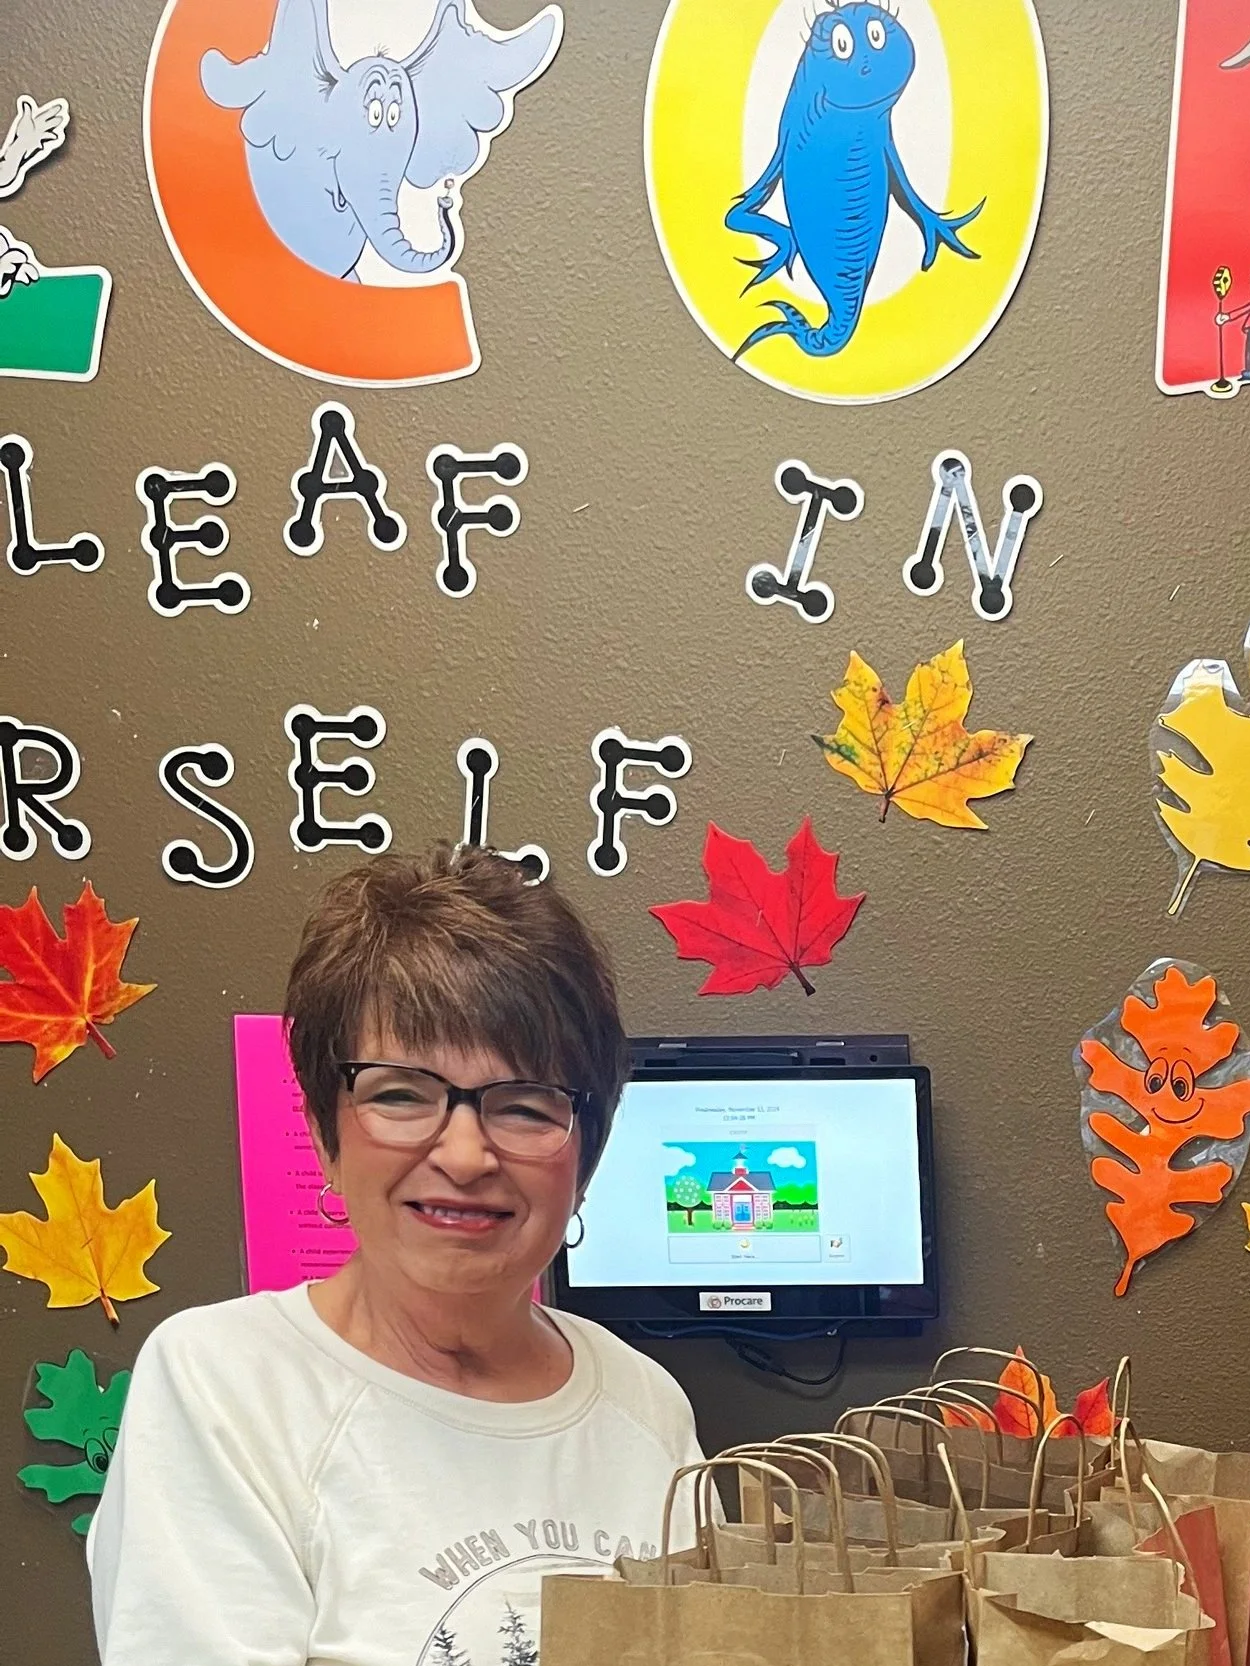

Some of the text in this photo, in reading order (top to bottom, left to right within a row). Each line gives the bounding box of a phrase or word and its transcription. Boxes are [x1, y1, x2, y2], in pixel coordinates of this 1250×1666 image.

[745, 449, 1043, 622] IN
[724, 1295, 763, 1306] Procare
[418, 1528, 510, 1591] WHEN
[513, 1519, 580, 1551] YOU
